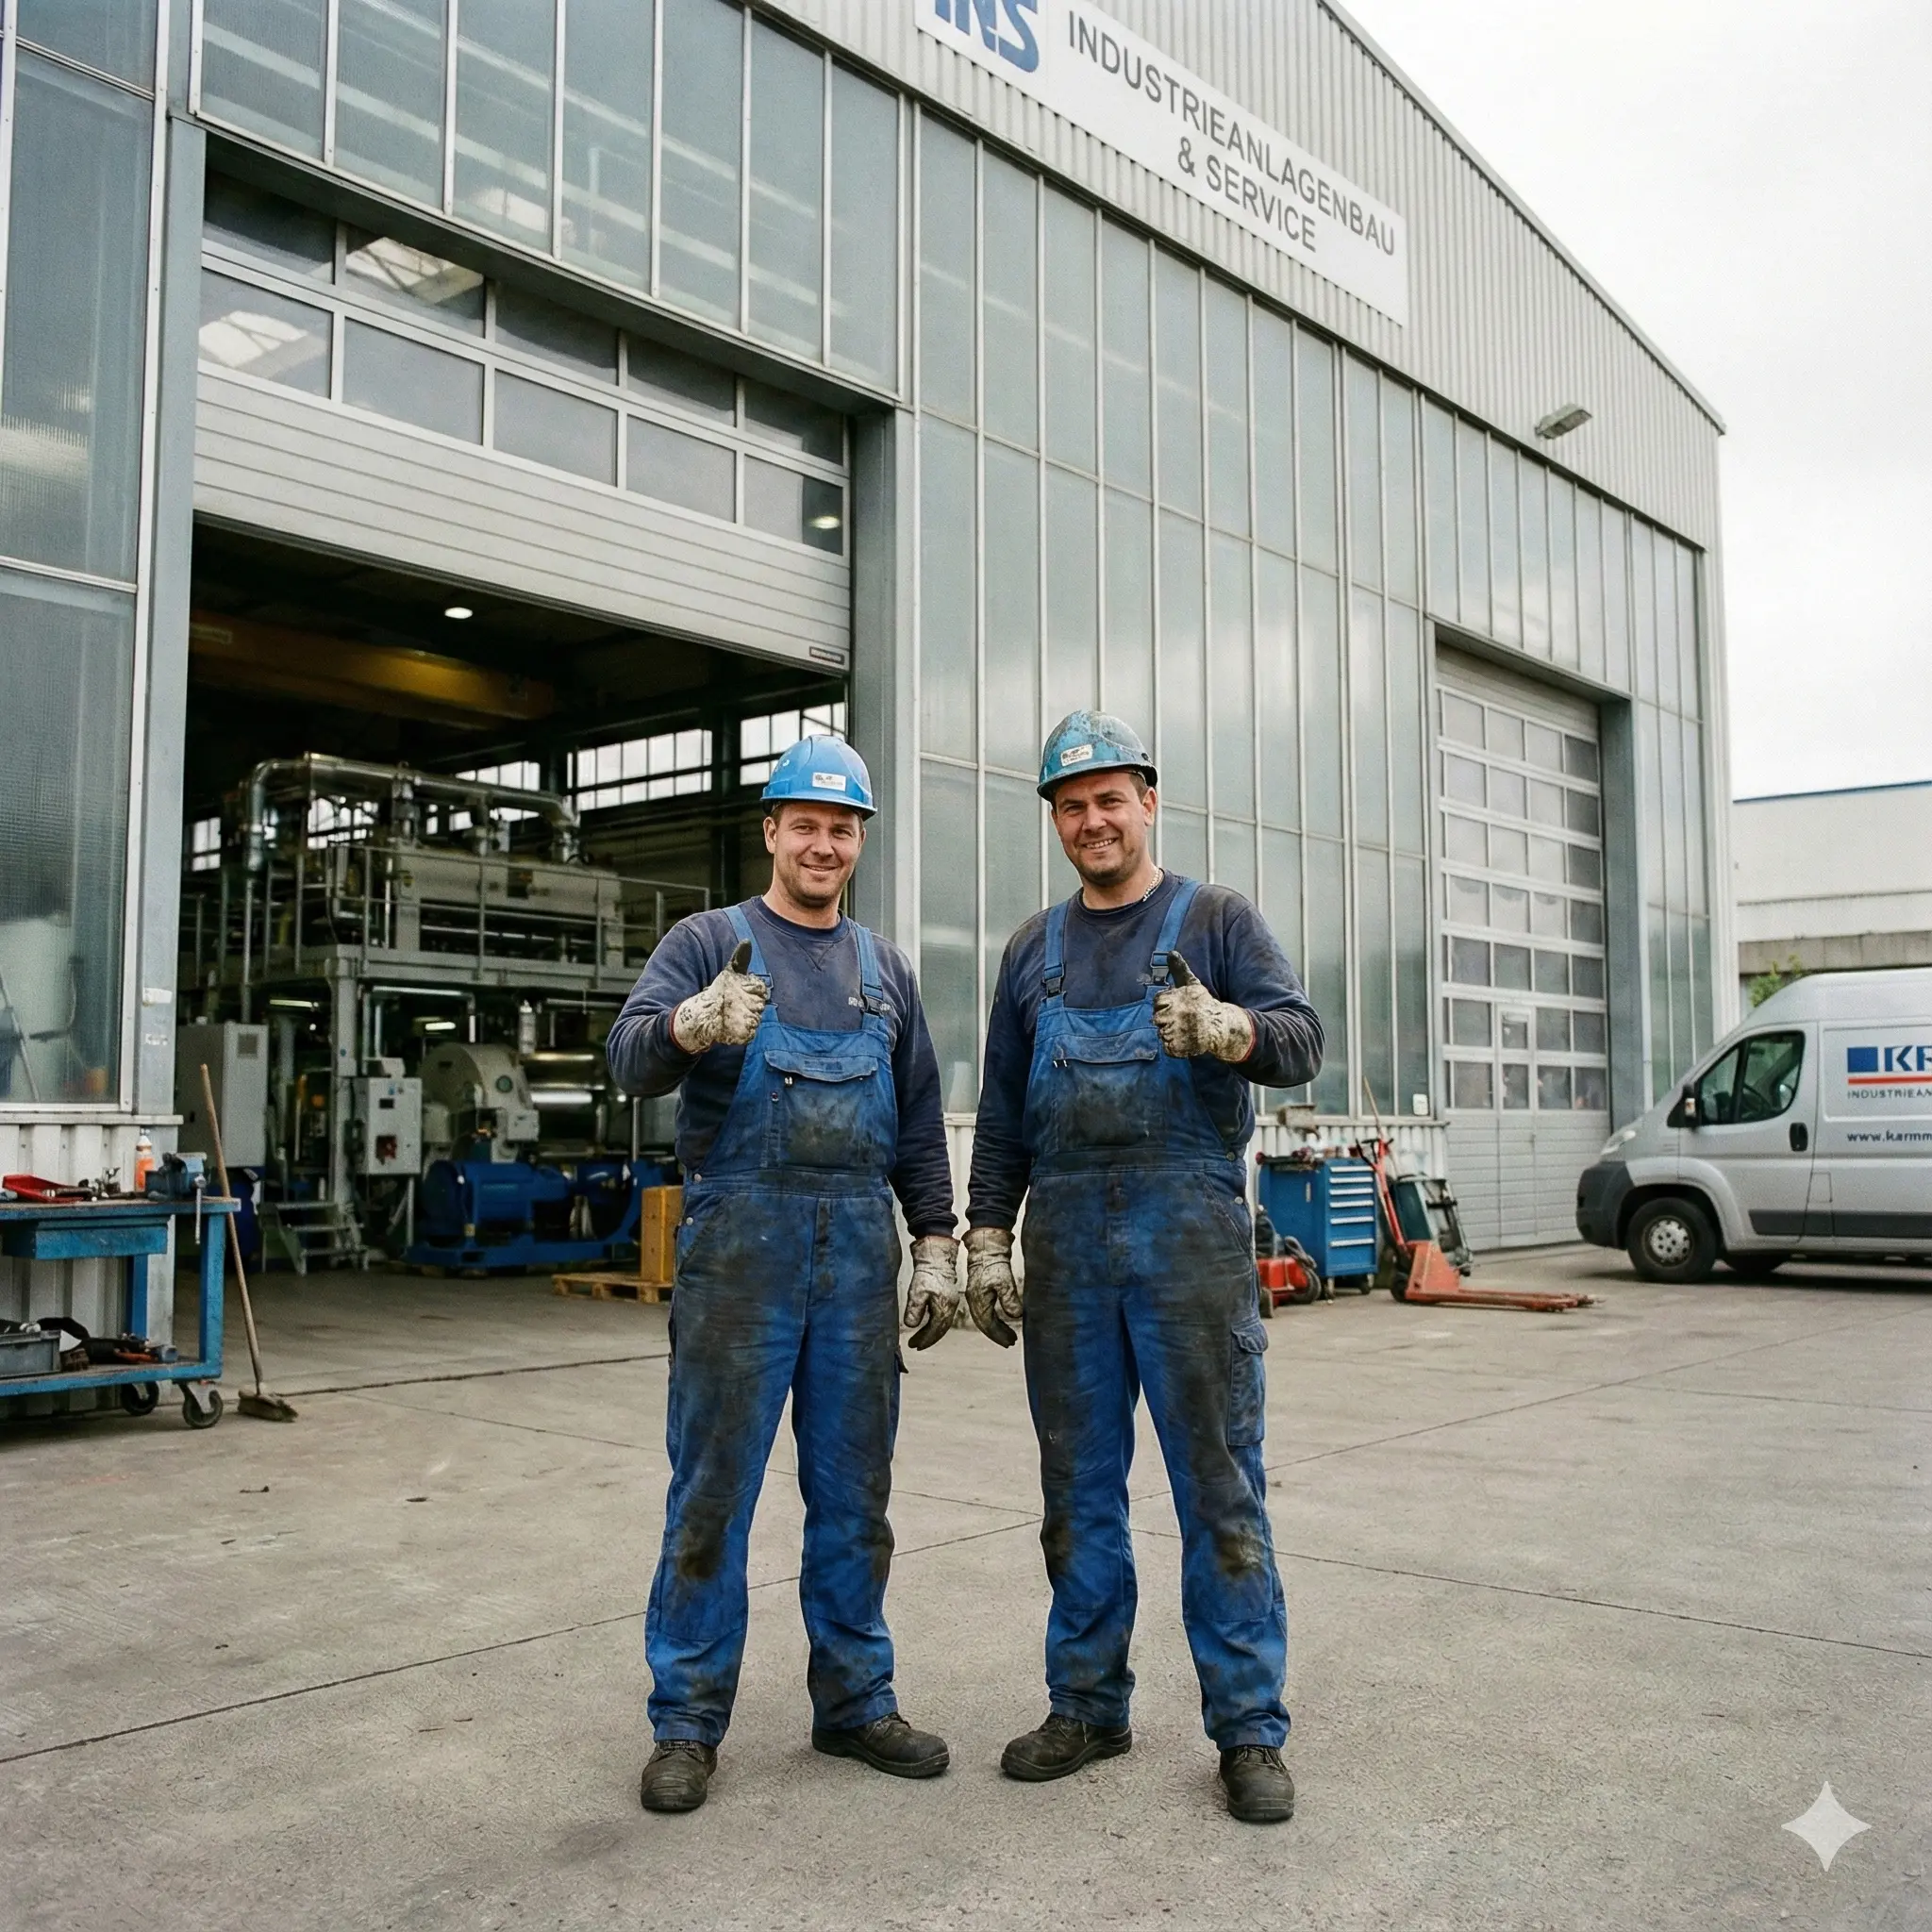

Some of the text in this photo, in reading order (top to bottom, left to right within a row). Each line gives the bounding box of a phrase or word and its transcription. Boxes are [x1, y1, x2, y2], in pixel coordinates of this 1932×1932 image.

[1069, 10, 1394, 256] INDUSTRIEANLAGENBAU
[1178, 136, 1316, 253] & SERVICE
